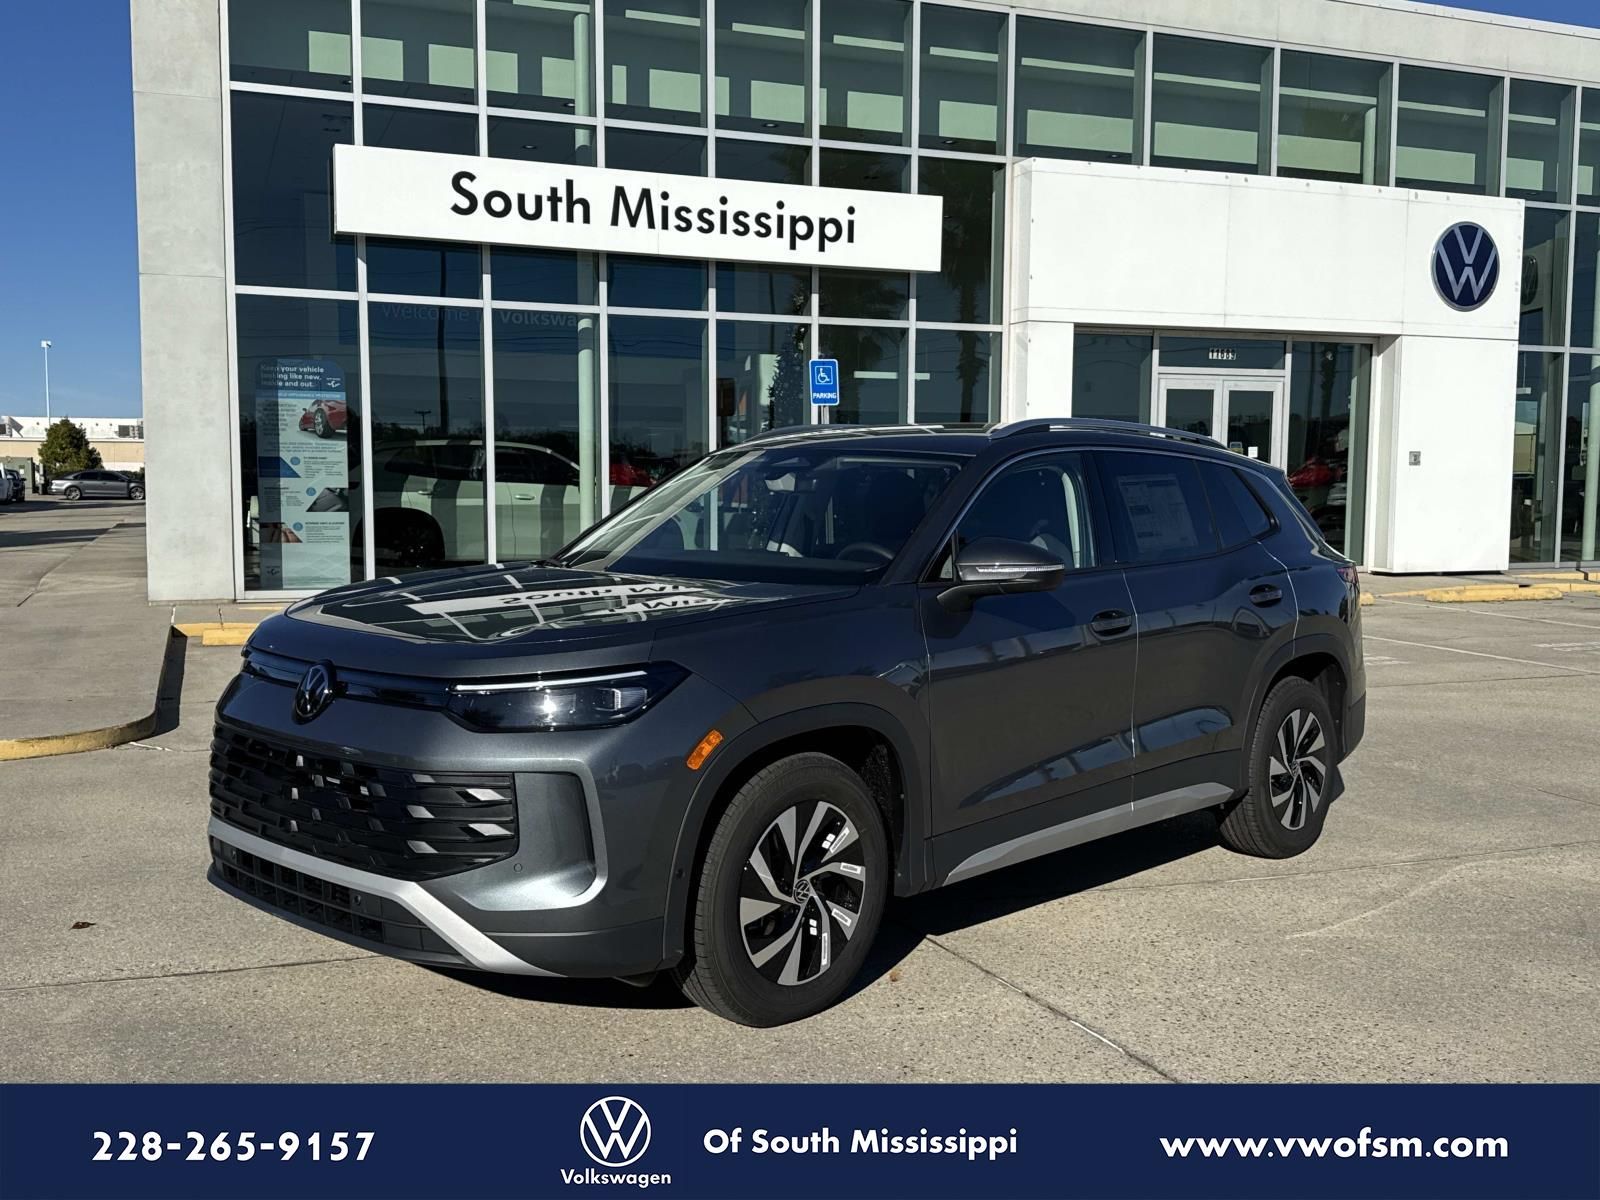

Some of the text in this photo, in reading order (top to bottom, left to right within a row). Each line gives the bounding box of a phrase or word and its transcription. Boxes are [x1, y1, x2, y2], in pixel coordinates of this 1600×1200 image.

[450, 170, 856, 252] South Mississippi
[1435, 224, 1498, 302] VW
[381, 303, 471, 321] Welcome
[500, 310, 577, 327] Volkswa
[289, 372, 303, 380] like
[299, 365, 324, 373] vehicle
[812, 392, 837, 400] PARKING
